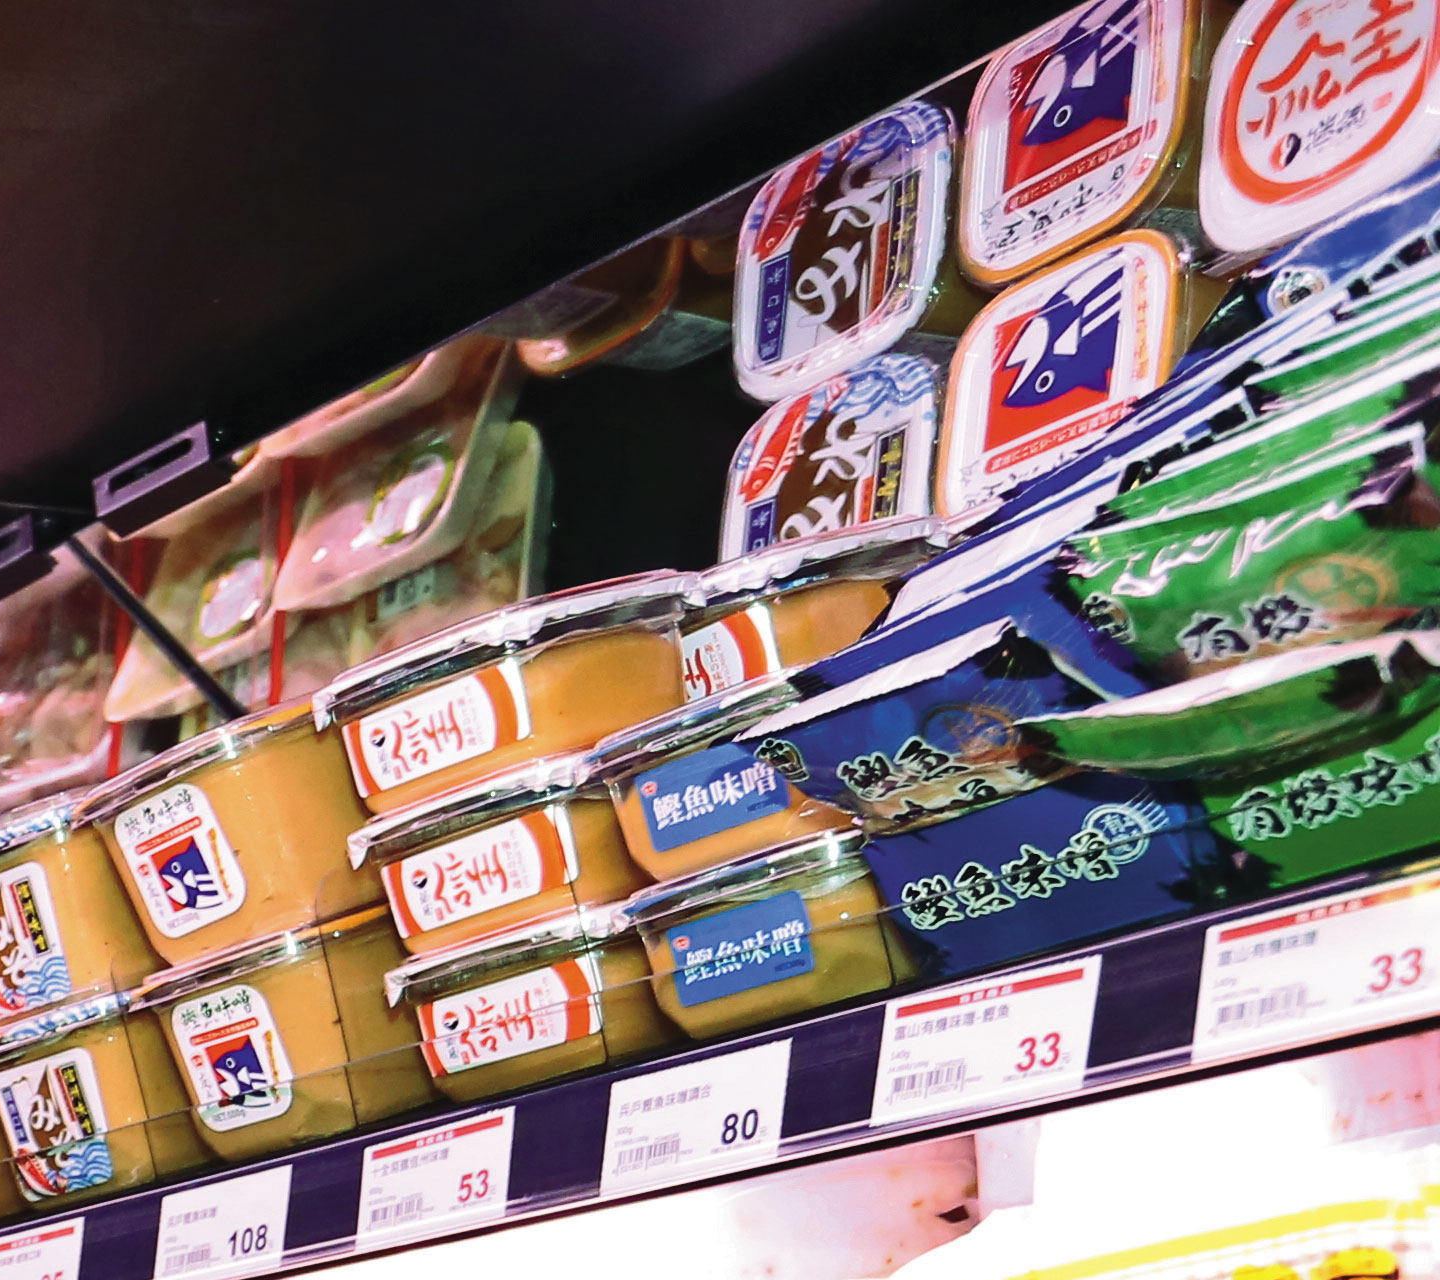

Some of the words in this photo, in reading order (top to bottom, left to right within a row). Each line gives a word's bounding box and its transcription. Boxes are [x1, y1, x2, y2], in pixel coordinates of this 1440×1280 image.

[1368, 946, 1425, 993] 33
[1015, 1031, 1062, 1073] 33
[721, 1108, 759, 1146] 80
[457, 1168, 490, 1204] 53
[227, 1224, 269, 1257] 108
